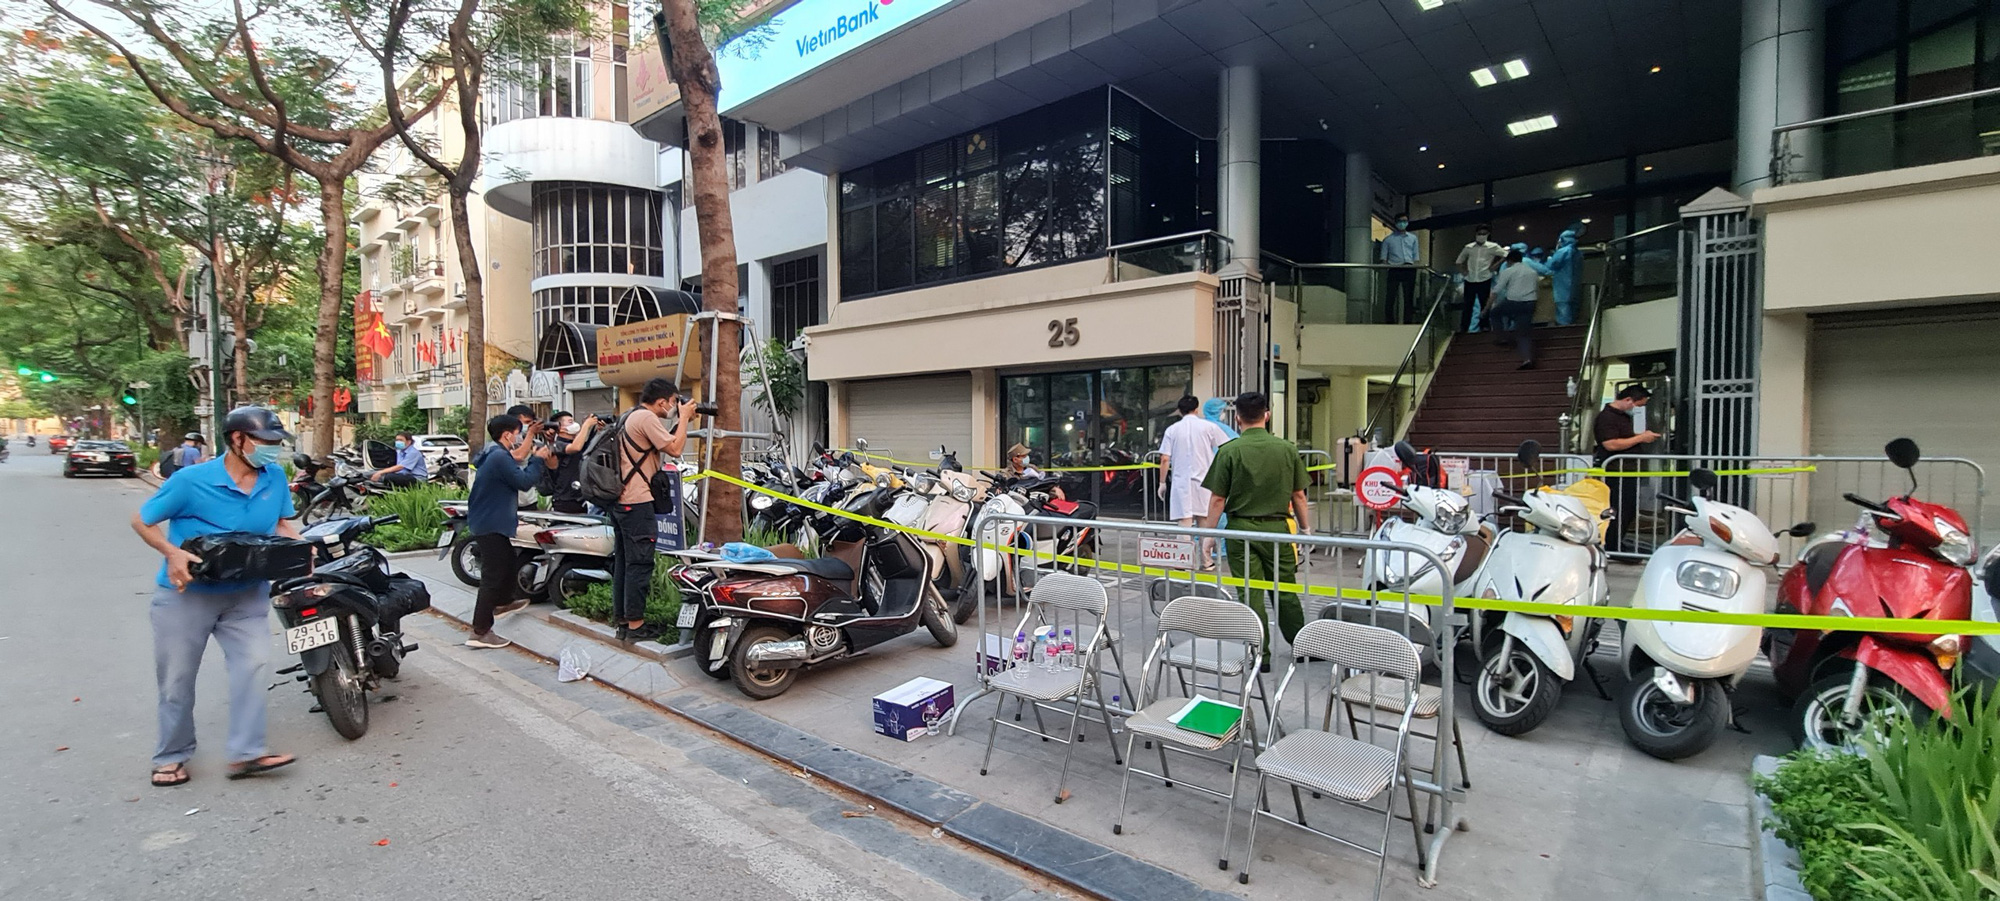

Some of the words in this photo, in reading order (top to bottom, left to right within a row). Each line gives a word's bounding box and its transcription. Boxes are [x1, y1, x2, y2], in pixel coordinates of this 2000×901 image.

[796, 1, 879, 57] VietinBank
[1048, 317, 1080, 348] 25
[291, 630, 335, 652] 673.16
[294, 620, 328, 639] 29-C1
